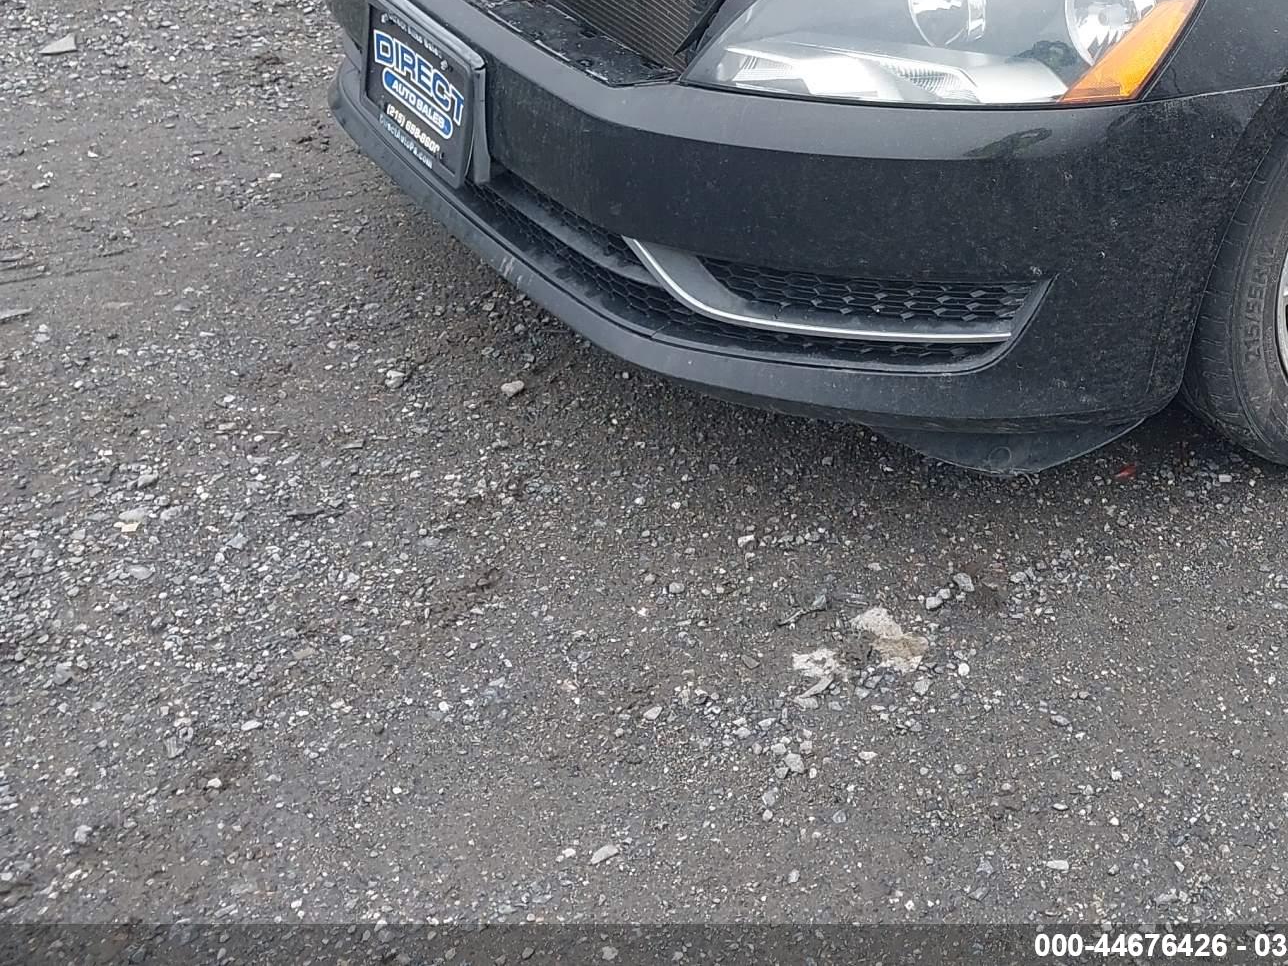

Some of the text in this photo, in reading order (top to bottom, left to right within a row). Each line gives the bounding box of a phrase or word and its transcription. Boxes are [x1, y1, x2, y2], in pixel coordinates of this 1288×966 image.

[373, 29, 465, 126] DIRECT
[386, 103, 406, 128] (215)
[391, 79, 445, 130] AUTO SALES
